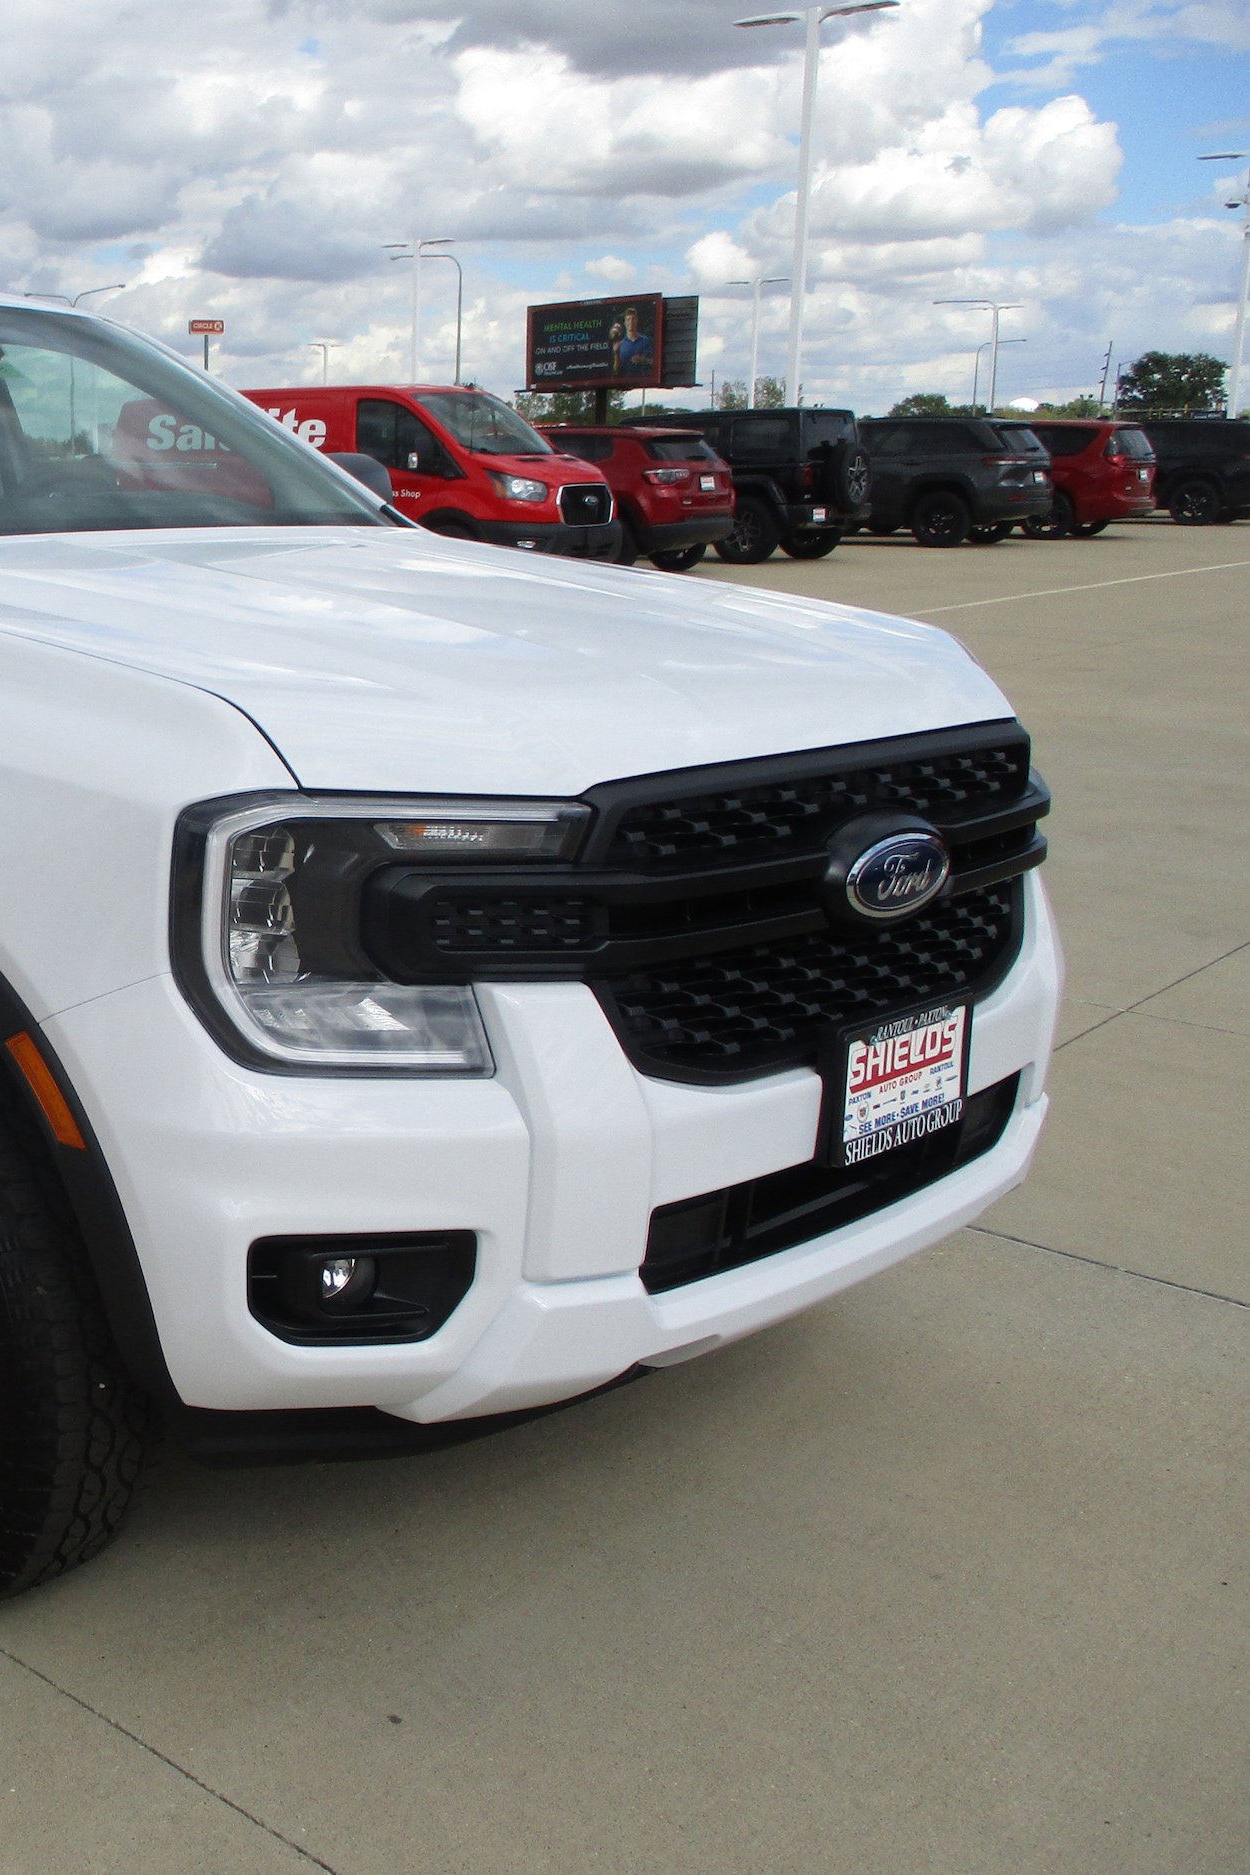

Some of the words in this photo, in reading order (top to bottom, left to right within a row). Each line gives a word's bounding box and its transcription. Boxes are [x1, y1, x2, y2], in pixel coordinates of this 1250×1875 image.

[544, 323, 572, 332] MENTAL
[573, 320, 602, 329] HEALTH
[557, 333, 590, 342] CRITICAL
[400, 488, 421, 499] Shop
[877, 851, 931, 901] Ford
[877, 1016, 915, 1041] RANTOUL
[849, 1018, 959, 1088] SHIELDS
[929, 1061, 954, 1075] RANTOUL
[878, 1080, 898, 1094] AUTO
[899, 1071, 923, 1087] GROUP
[848, 1091, 872, 1106] PAXTON
[858, 1121, 874, 1135] SEE
[900, 1101, 920, 1119] SAVE
[921, 1092, 945, 1109] MORE!
[845, 1127, 892, 1166] SHIELDS
[894, 1115, 925, 1148] AUTO
[926, 1098, 963, 1133] GROUP
